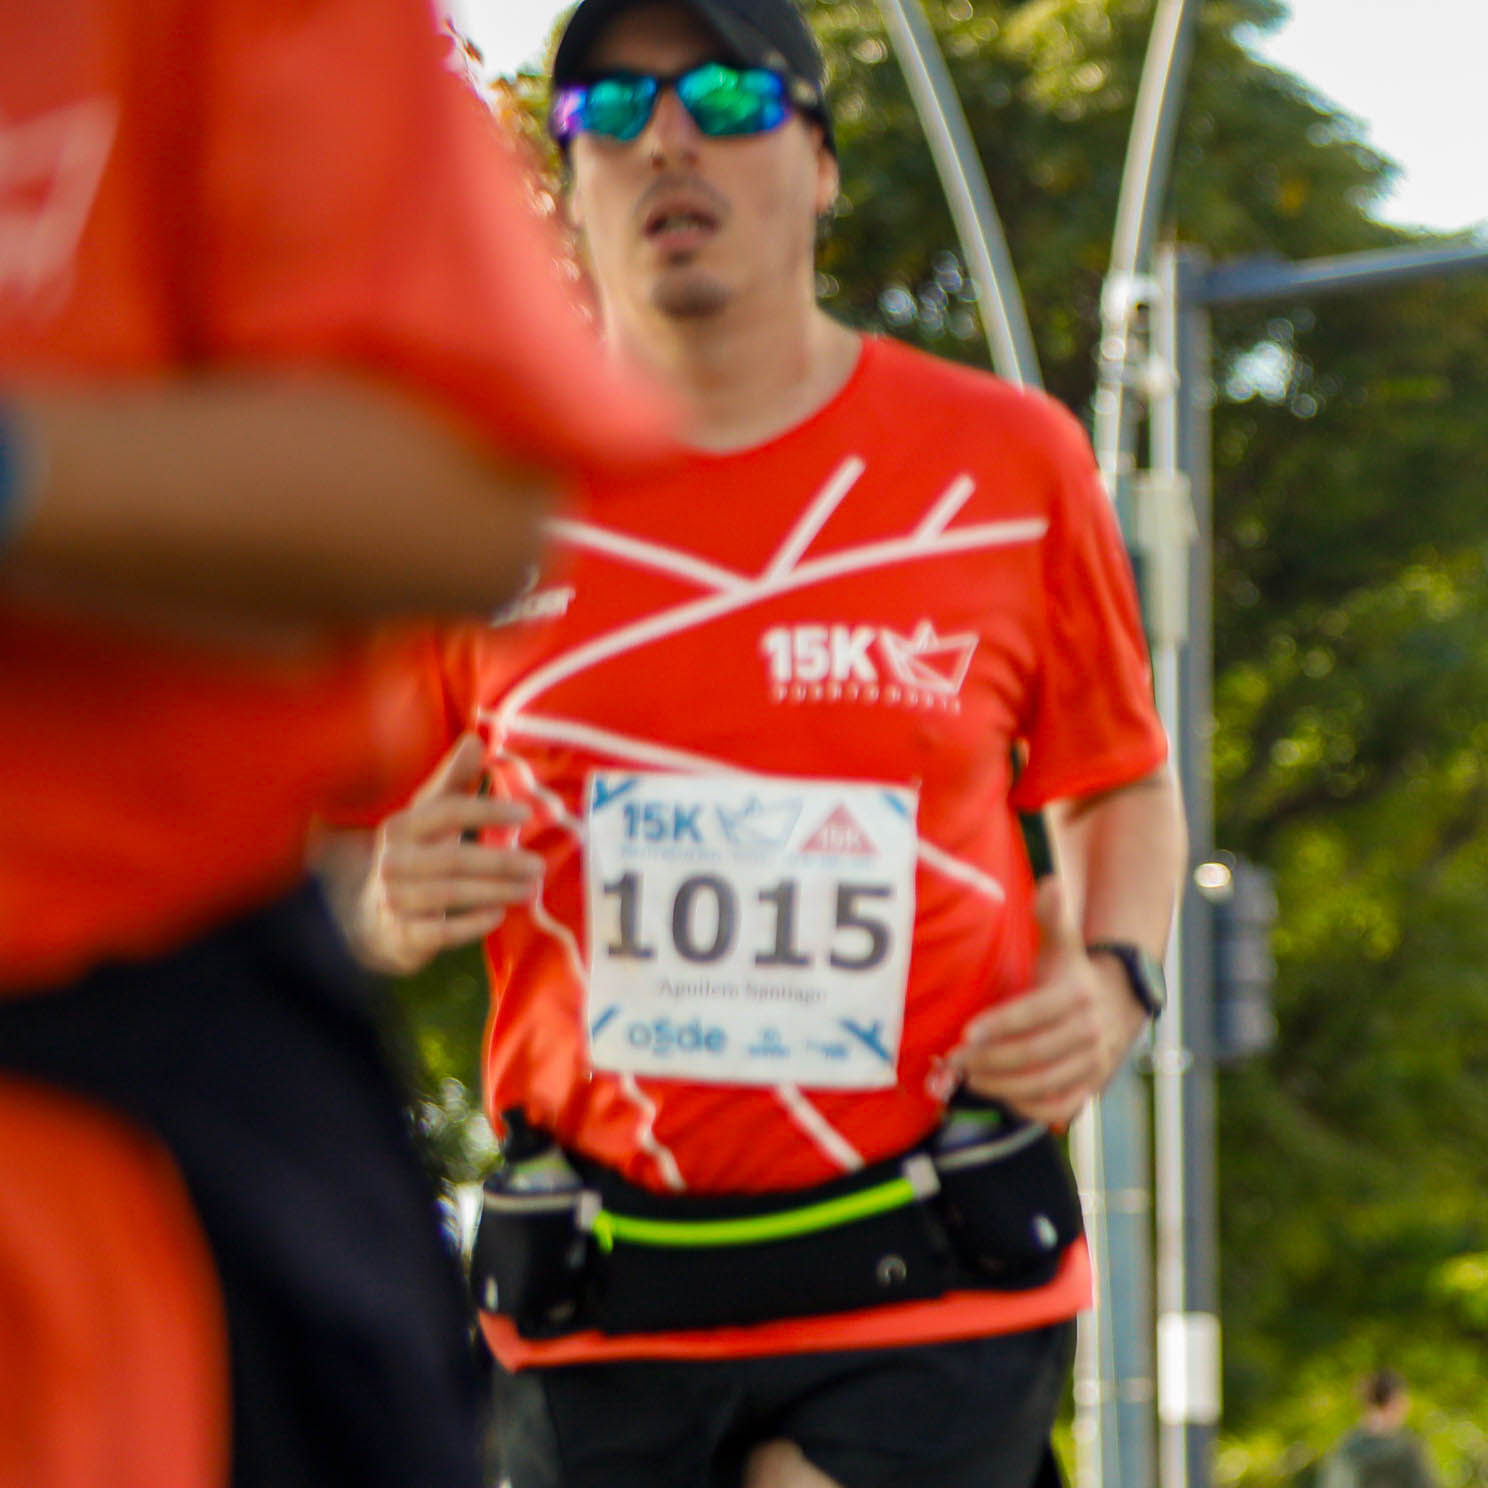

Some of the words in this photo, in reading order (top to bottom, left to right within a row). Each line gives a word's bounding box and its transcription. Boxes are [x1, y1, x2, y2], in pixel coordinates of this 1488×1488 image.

[761, 625, 878, 683] 15K
[623, 801, 702, 843] 15K
[602, 872, 893, 971] 1015
